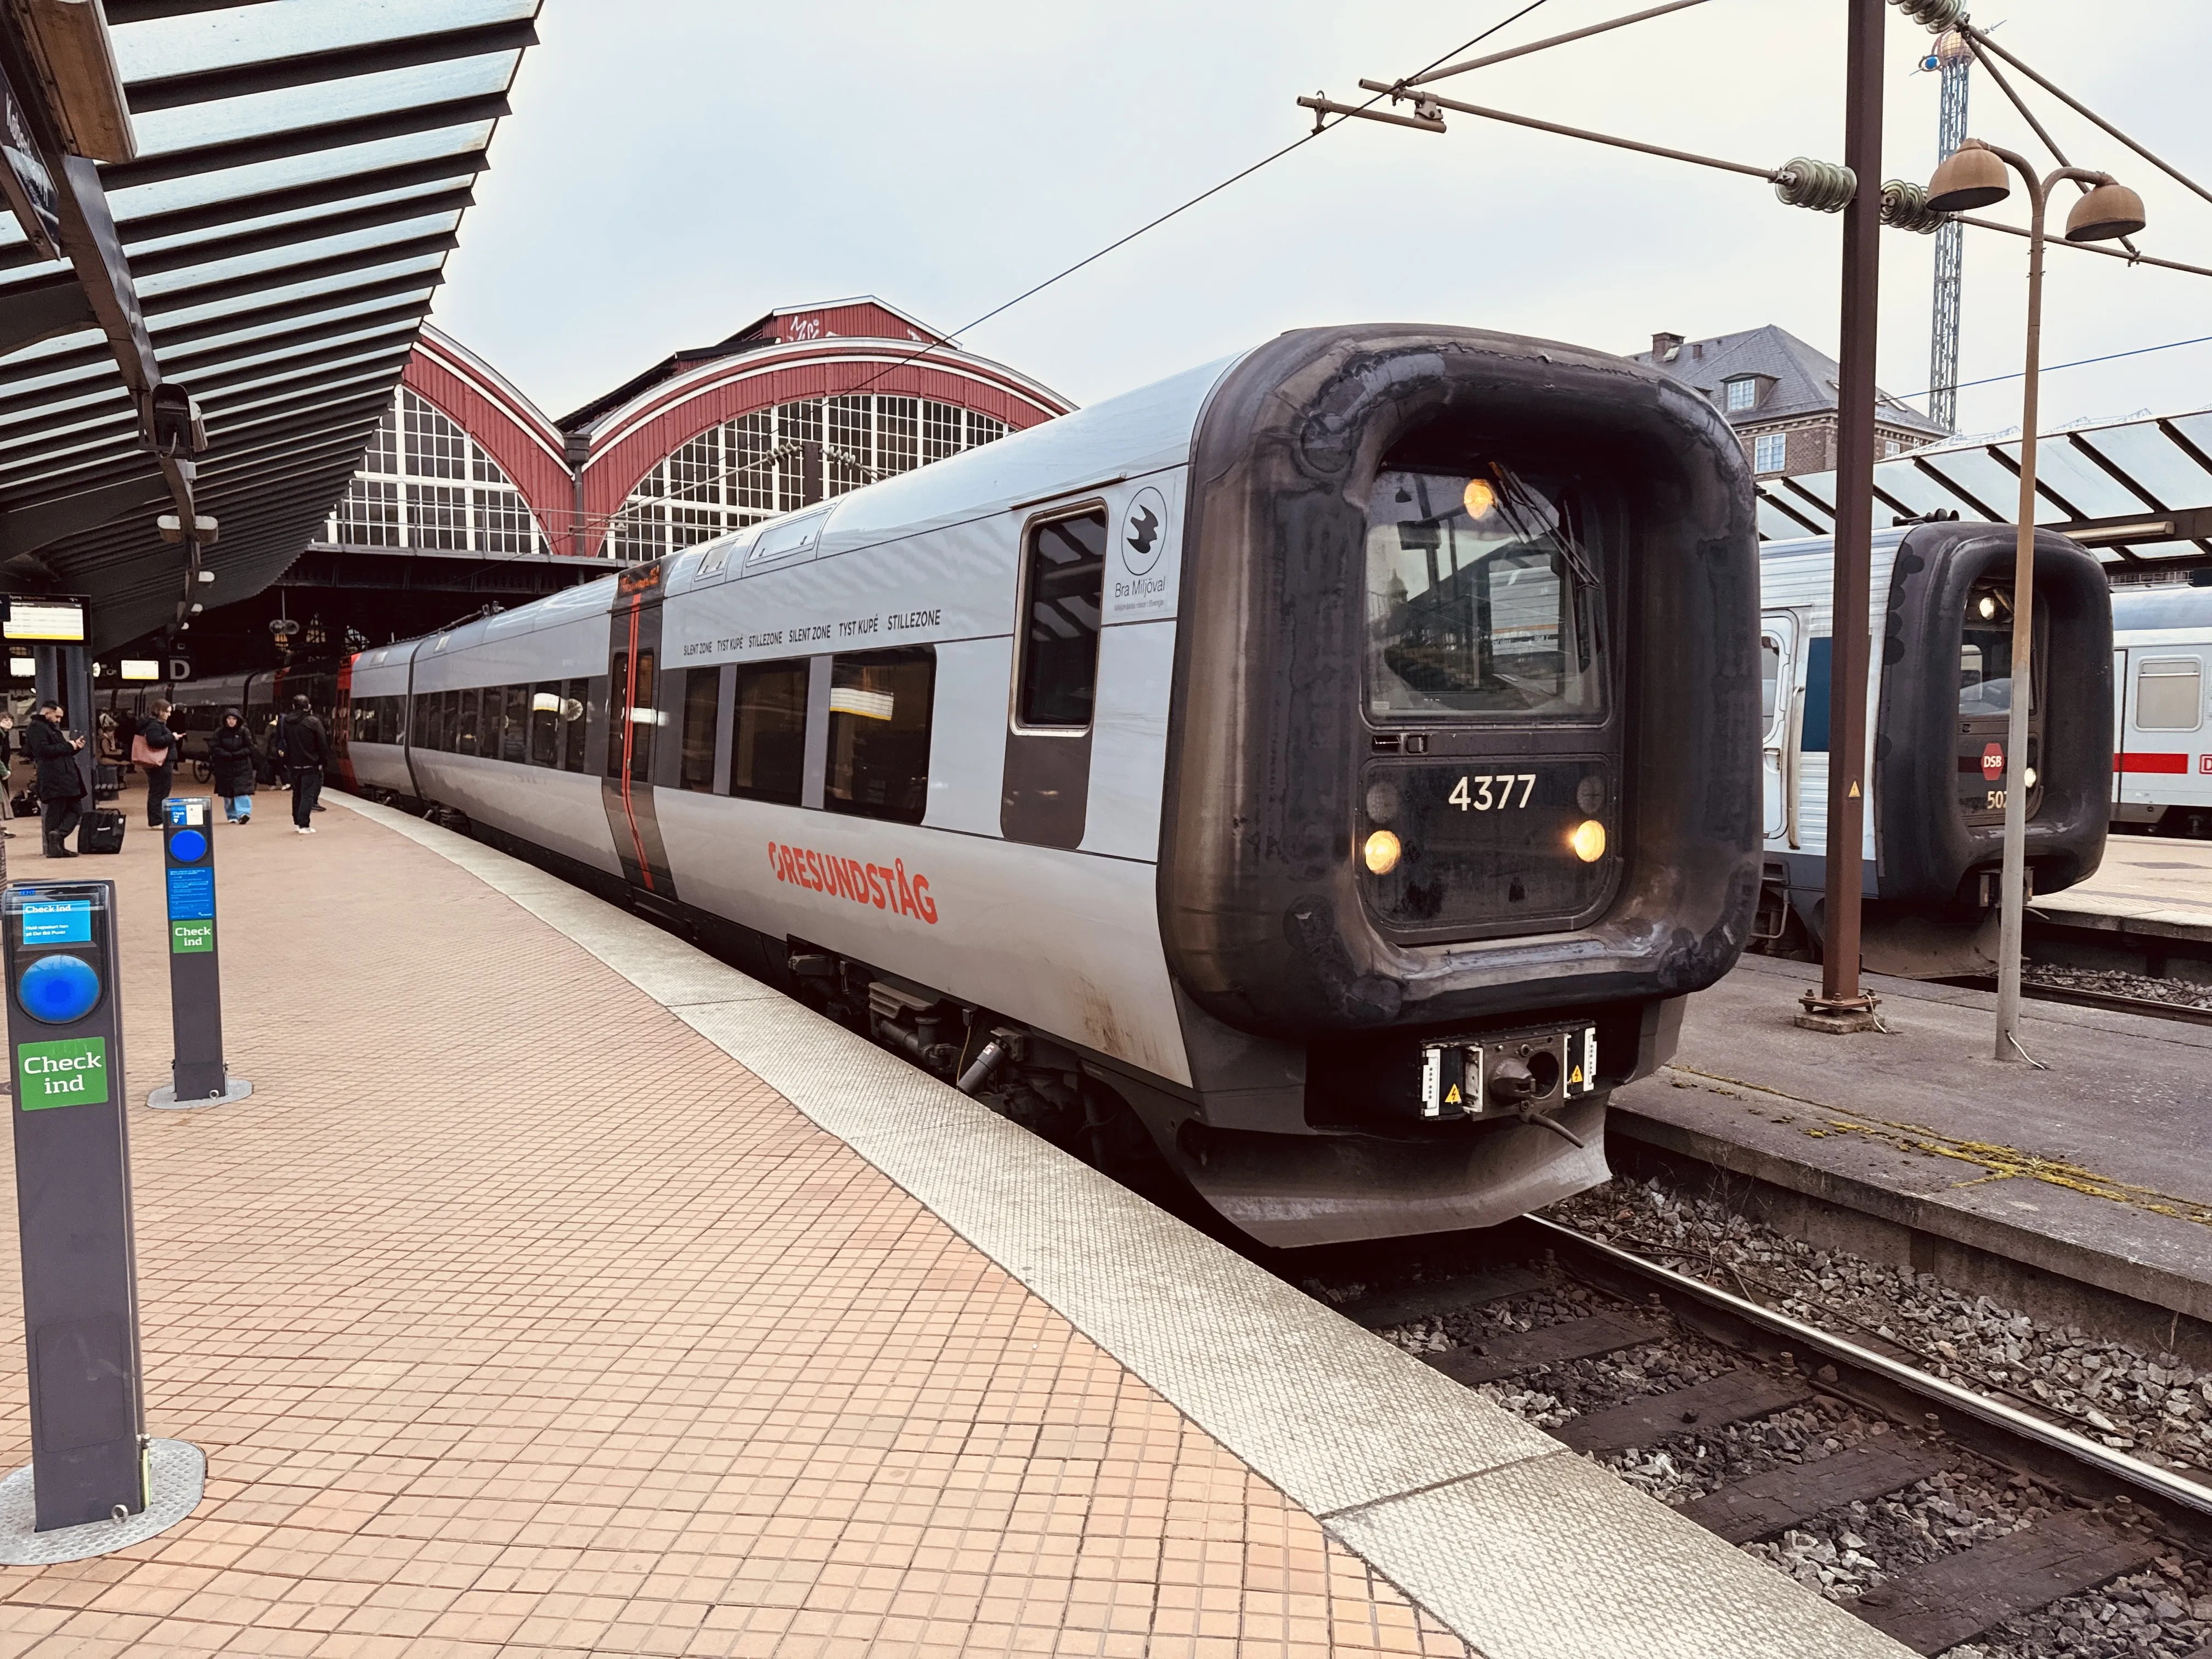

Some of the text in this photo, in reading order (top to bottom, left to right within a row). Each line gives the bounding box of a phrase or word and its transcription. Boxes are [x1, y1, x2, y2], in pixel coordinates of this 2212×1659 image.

[1115, 575, 1166, 598] Bra Miljöval
[684, 609, 941, 656] SILENT ZONE TYST KUPÉ STILLEZONE SILENT ZONE TYST KUPÉ STILLEZONE
[170, 659, 190, 680] D
[1983, 755, 2002, 768] DSB
[1448, 774, 1536, 811] 4377
[769, 841, 938, 924] ØRESUNDSTÅG
[25, 905, 55, 913] Check
[175, 927, 211, 936] Check
[184, 936, 202, 946] ind
[24, 1052, 102, 1074] Check
[44, 1074, 85, 1094] ind
